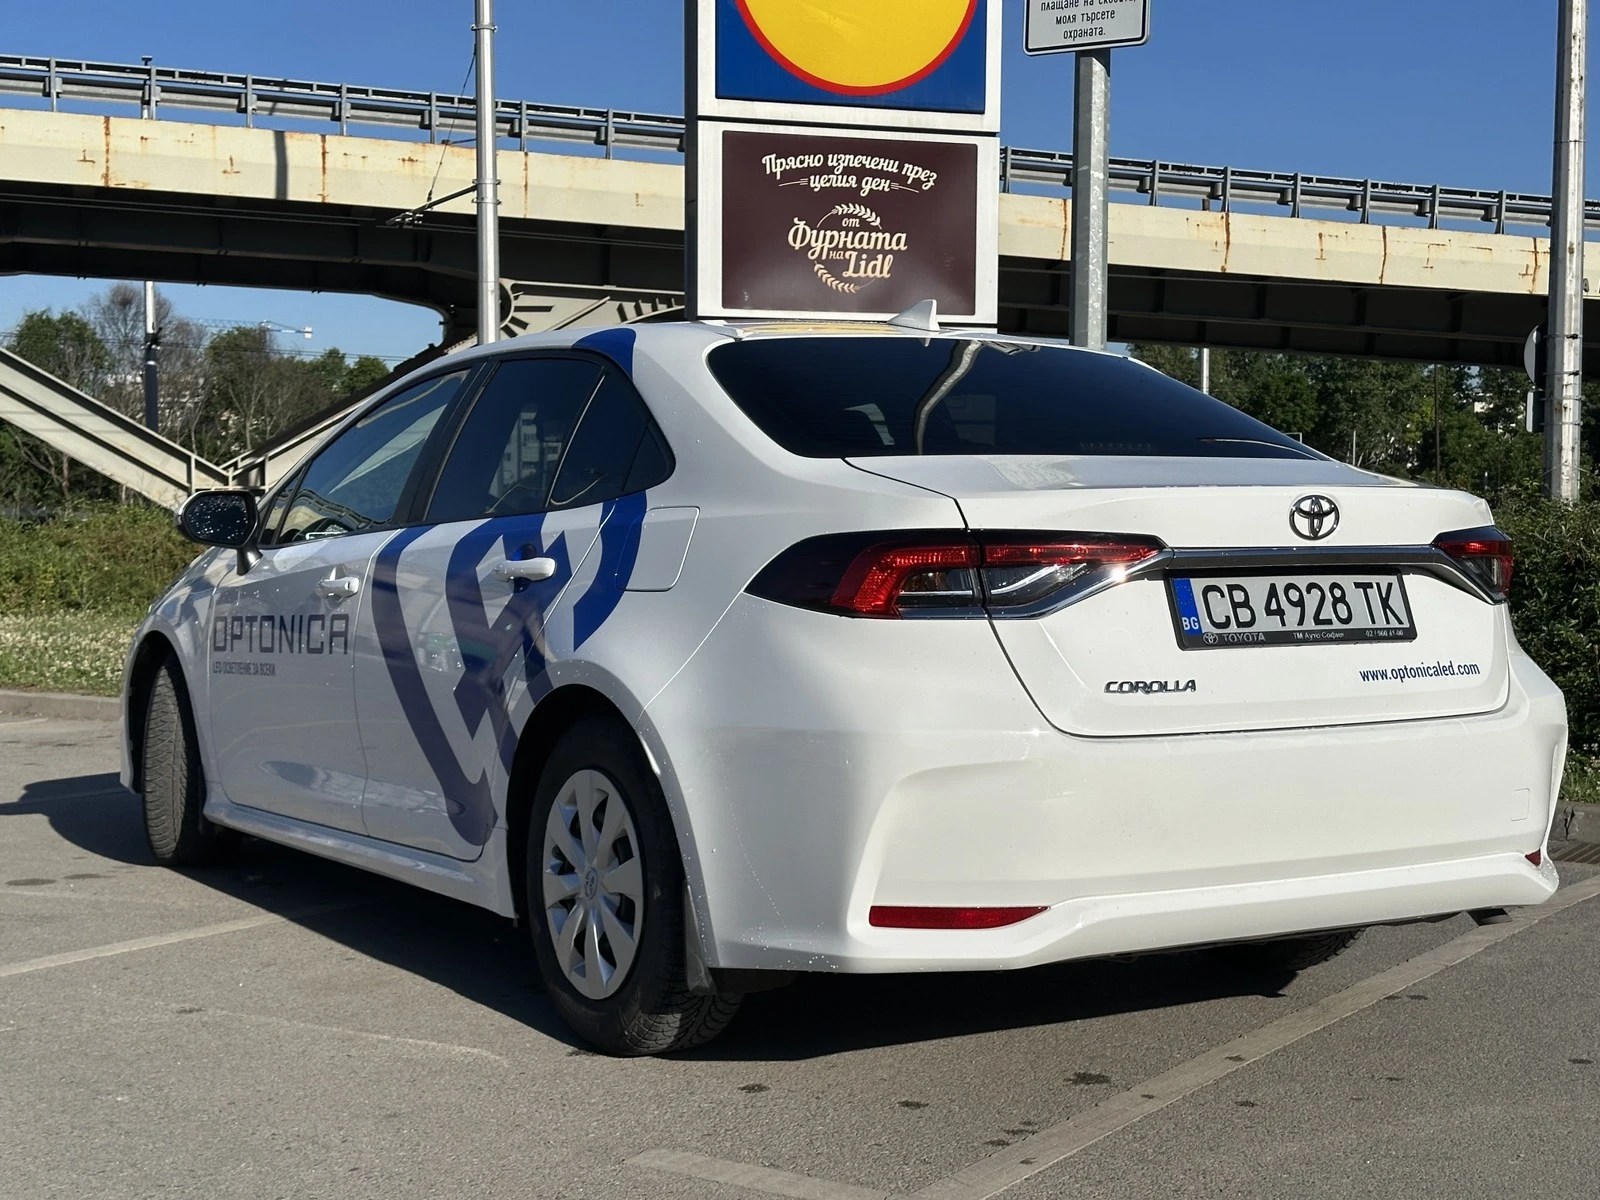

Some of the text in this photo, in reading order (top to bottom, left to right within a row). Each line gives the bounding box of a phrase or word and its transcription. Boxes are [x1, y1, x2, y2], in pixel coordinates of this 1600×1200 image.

[1041, 0, 1079, 11] плащане
[1056, 10, 1115, 25] моля търсете
[1063, 26, 1106, 41] охраната.
[761, 153, 938, 190] Прясно изпечени през
[810, 173, 891, 197] целия ден
[842, 217, 860, 227] от
[788, 217, 908, 260] Фурната
[829, 251, 844, 260] на
[842, 250, 894, 279] Lidl
[1201, 581, 1404, 629] CB 4928 TK
[1181, 616, 1199, 631] BG
[213, 613, 349, 655] OPTONICA
[1221, 632, 1266, 643] TOYOTA
[1359, 660, 1480, 683] www.optonicaled.com
[1104, 679, 1196, 694] COROLLA
